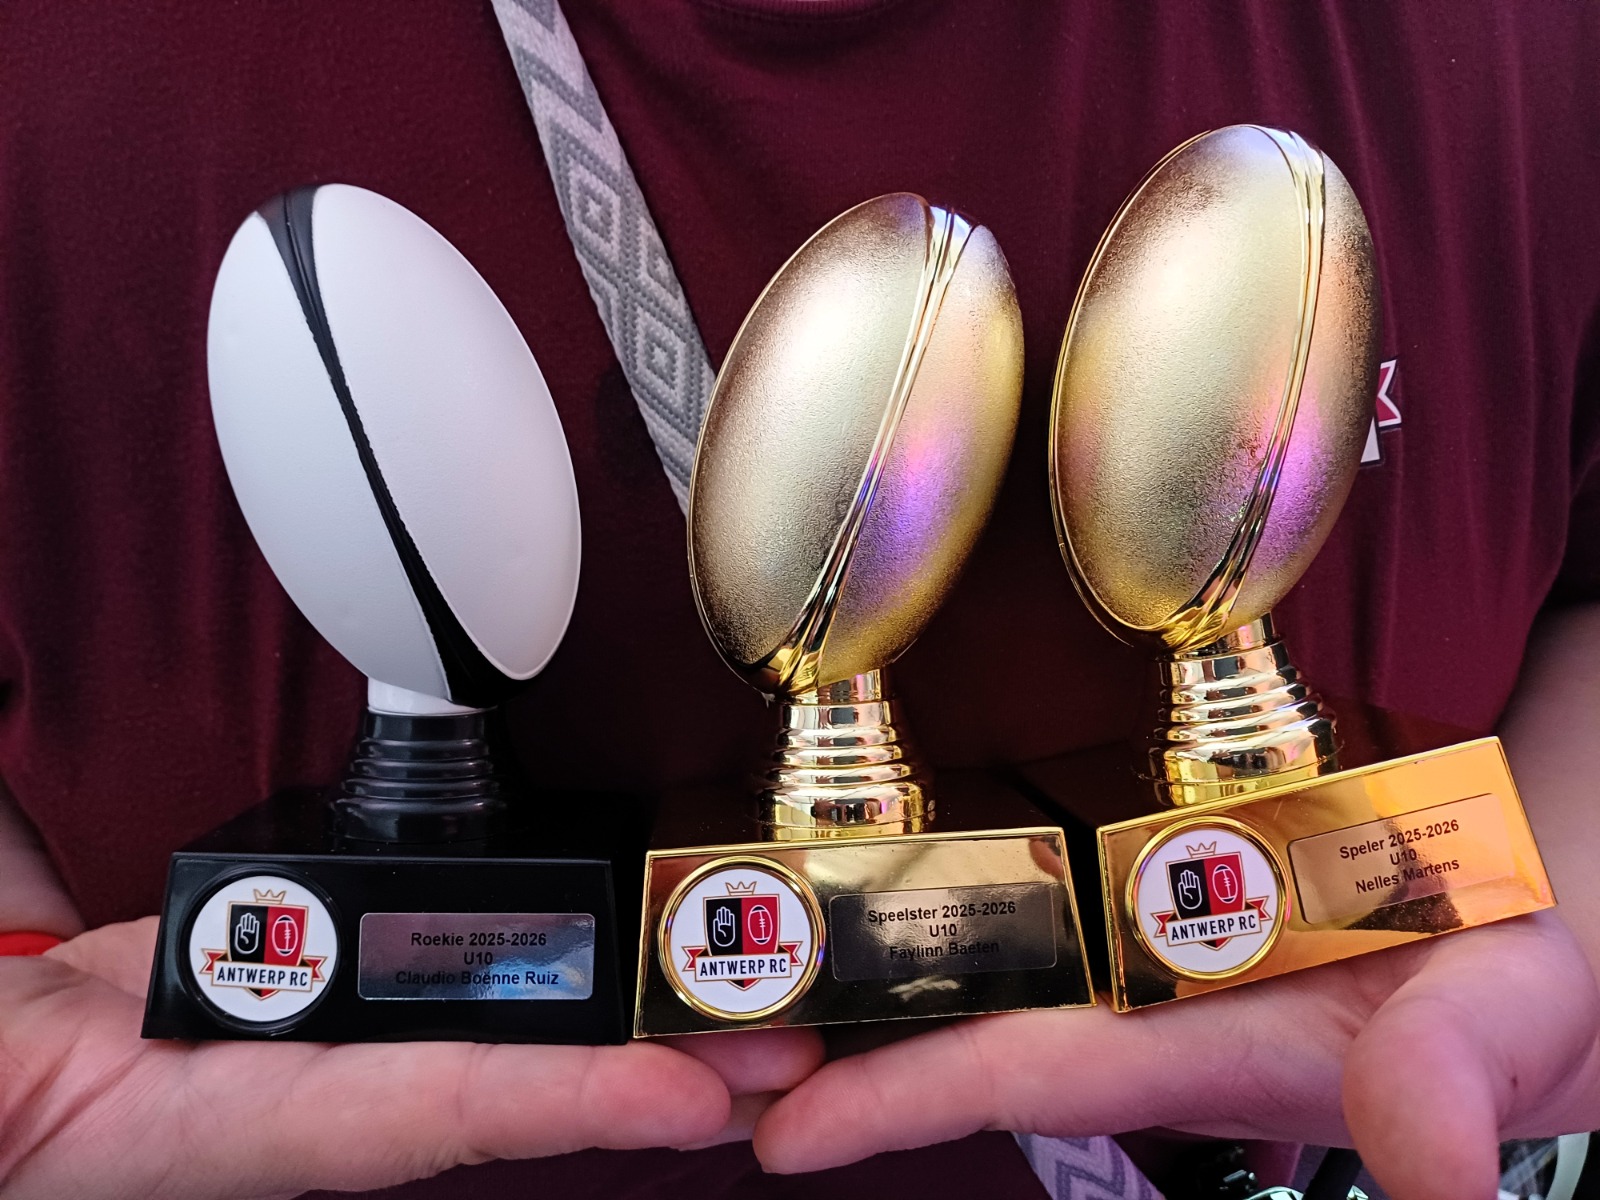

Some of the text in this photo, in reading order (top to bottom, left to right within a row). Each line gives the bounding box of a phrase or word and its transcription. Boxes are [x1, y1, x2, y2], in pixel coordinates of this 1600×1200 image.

[1338, 819, 1460, 861] Speler 2025-2026
[1389, 848, 1418, 867] U10
[1355, 857, 1461, 895] Nelles Martens
[868, 901, 1016, 926] Speelster 2025-2026
[928, 923, 958, 938] U10
[1171, 913, 1257, 942] ANTWERP RC
[410, 932, 547, 947] Roekie 2025-2026
[463, 952, 494, 967] U10
[889, 940, 1000, 962] Faylinn Baeten
[216, 965, 309, 988] ANTWERP RC
[699, 957, 788, 977] ANTWERP RC
[395, 970, 457, 986] Claudio
[524, 970, 560, 986] Ruiz
